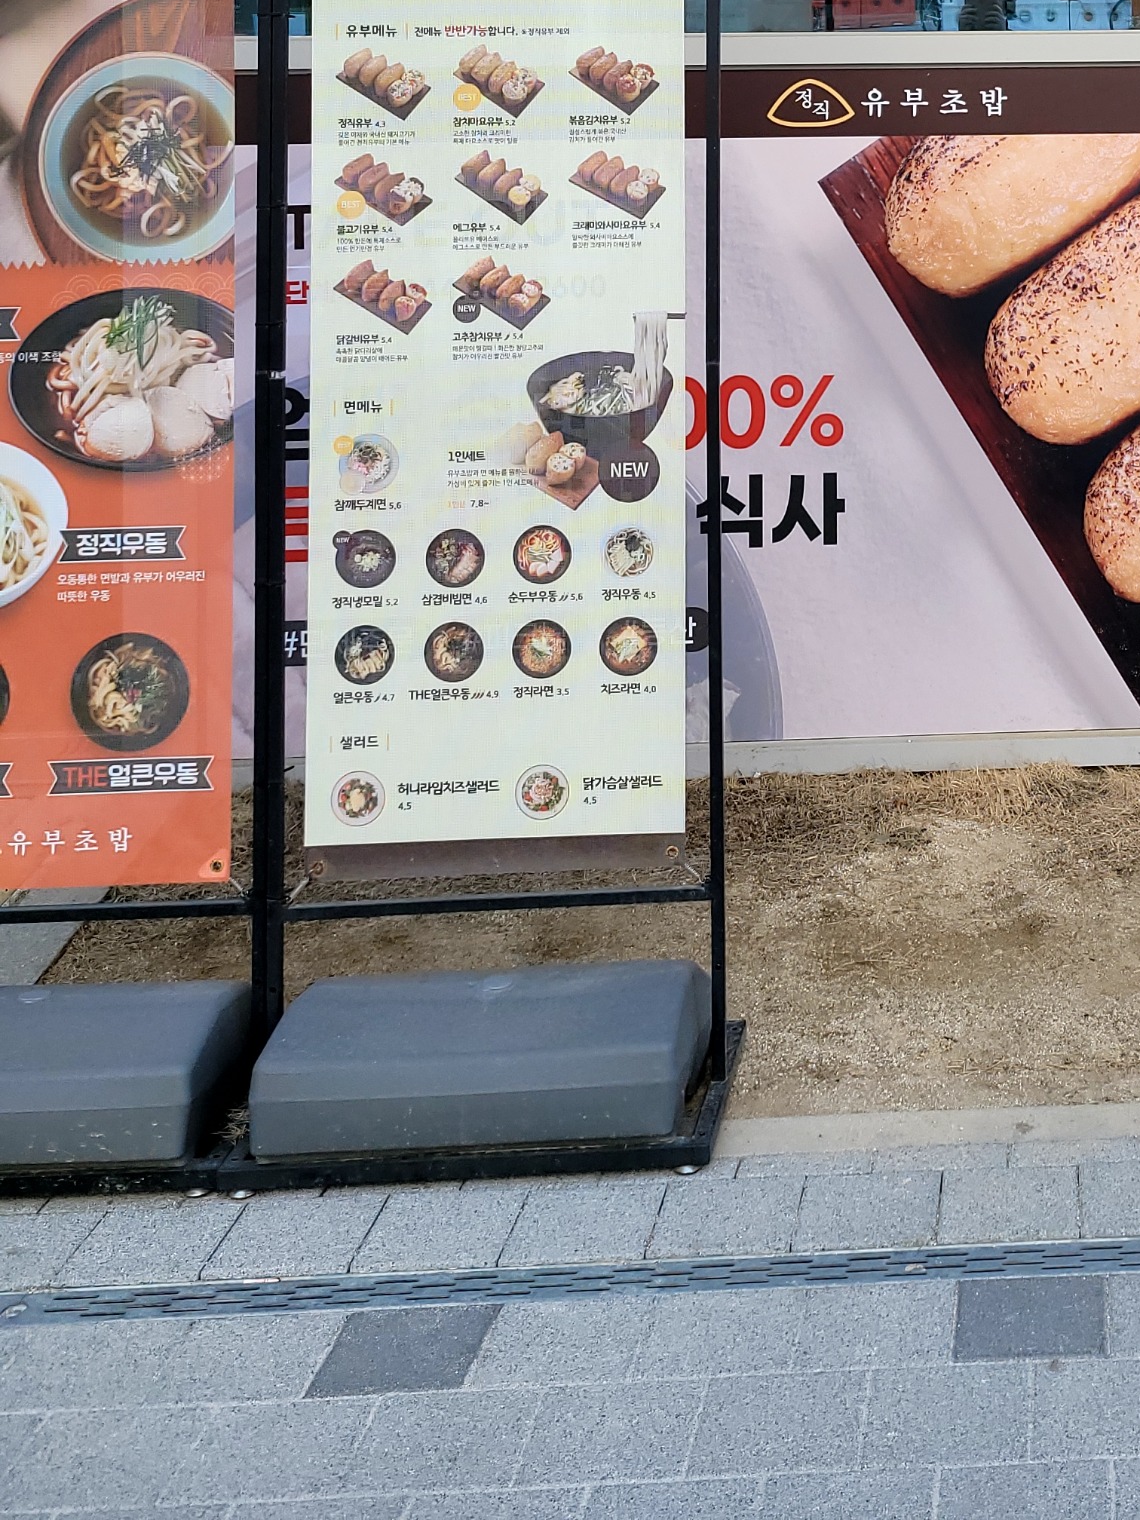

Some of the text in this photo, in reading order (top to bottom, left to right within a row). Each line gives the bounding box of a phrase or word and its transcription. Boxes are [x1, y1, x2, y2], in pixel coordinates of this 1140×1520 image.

[346, 24, 398, 38] 유부메뉴
[414, 26, 442, 37] 전메뉴
[444, 25, 518, 37] 반반가능합니다.
[795, 86, 1008, 120] 정직 유부초밥
[338, 118, 373, 129] 정직유부
[453, 116, 504, 127] 참치마요유부
[620, 117, 631, 125] 5.2
[337, 225, 379, 236] 불고기유부
[453, 223, 500, 233] 에그유부 5.4
[458, 304, 476, 313] NEW
[336, 334, 392, 345] 닭갈비유부 5.4
[452, 332, 524, 343] 고추참치유부 5.4
[18, 351, 39, 363] 이색
[343, 400, 383, 415] 면메뉴
[448, 450, 486, 463] 1인세트
[610, 462, 649, 478] NEW
[388, 500, 402, 510] 5.6
[76, 531, 168, 557] 정직우동
[57, 570, 206, 585] 오동통한 면발과 유부가 어우러진
[57, 590, 111, 602] 따뜻한 우동
[421, 593, 488, 606] 삼겹비빔면 4.6
[508, 590, 583, 603] 순두부우동 5.6
[601, 588, 656, 601] 정직우동 4.5
[332, 595, 399, 608] 정직냉모밀 5.2
[408, 688, 499, 702] THE얼큰우동 4.9
[513, 685, 570, 698] 정직라면 3.5
[601, 682, 657, 695] 치즈라면 4.0
[333, 690, 395, 704] 얼큰우동 4.7
[340, 735, 380, 750] 샐러드
[62, 762, 200, 789] THE얼큰우동
[398, 780, 500, 796] 허니라임치즈샐러드
[583, 775, 664, 791] 닭가슴살샐러드
[398, 801, 412, 811] 4.5
[583, 796, 597, 806] 4.5
[7, 827, 133, 856] 유부초밥
